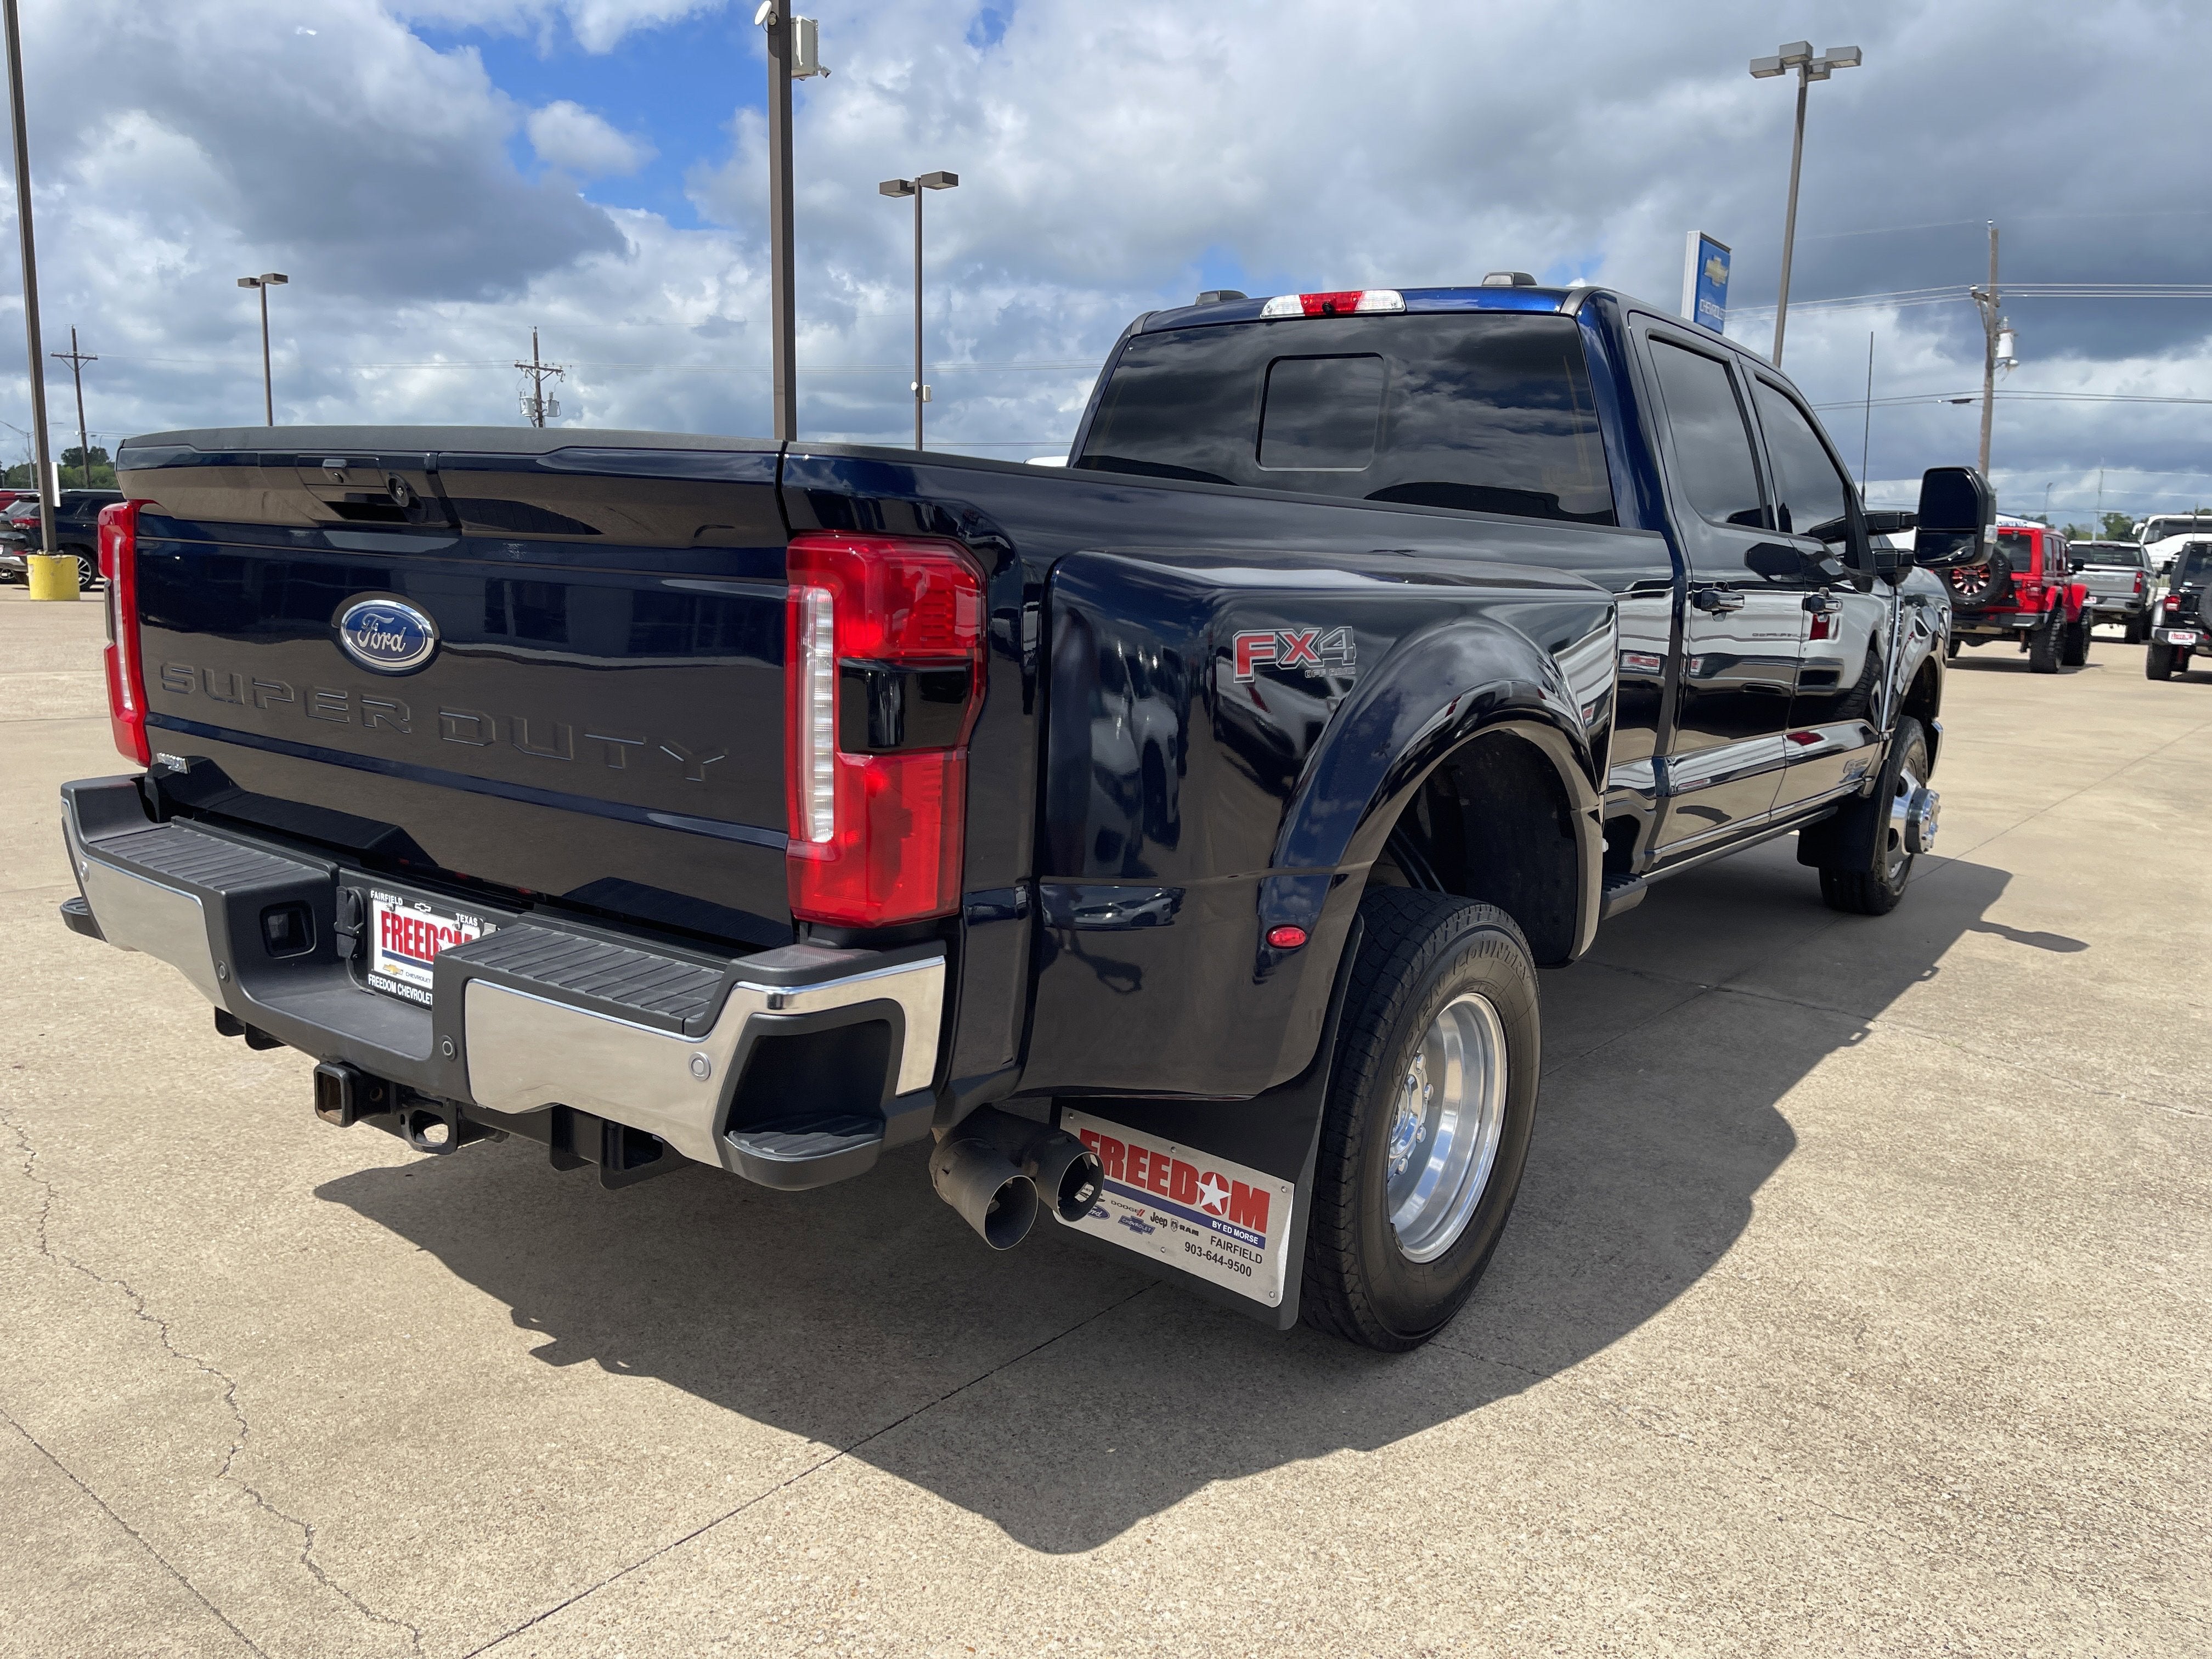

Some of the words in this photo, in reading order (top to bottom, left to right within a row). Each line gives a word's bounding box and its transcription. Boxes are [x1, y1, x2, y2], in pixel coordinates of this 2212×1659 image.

[357, 613, 407, 652] Ford
[1233, 626, 1357, 683] FX4
[1305, 668, 1326, 678] OFF
[161, 663, 411, 734] SUPER
[439, 706, 729, 782] DUTY
[370, 890, 403, 906] FAIRFIELD
[455, 913, 478, 926] TEXAS
[405, 972, 431, 983] CHEVROLET
[1453, 939, 1531, 981] COUNTRY
[368, 974, 397, 994] FREEDOM
[397, 984, 433, 1005] CHEVROLET
[1111, 1200, 1140, 1214] DODGE
[1150, 1212, 1167, 1228] Jeep
[1180, 1224, 1199, 1236] RAM
[1122, 1218, 1152, 1232] CHEVROLET
[1212, 1220, 1222, 1229] BY
[1223, 1225, 1232, 1233] ED
[1234, 1229, 1259, 1244] MORSE
[1184, 1242, 1252, 1277] 903-644-9500
[1210, 1235, 1262, 1264] FAIRFIELD
